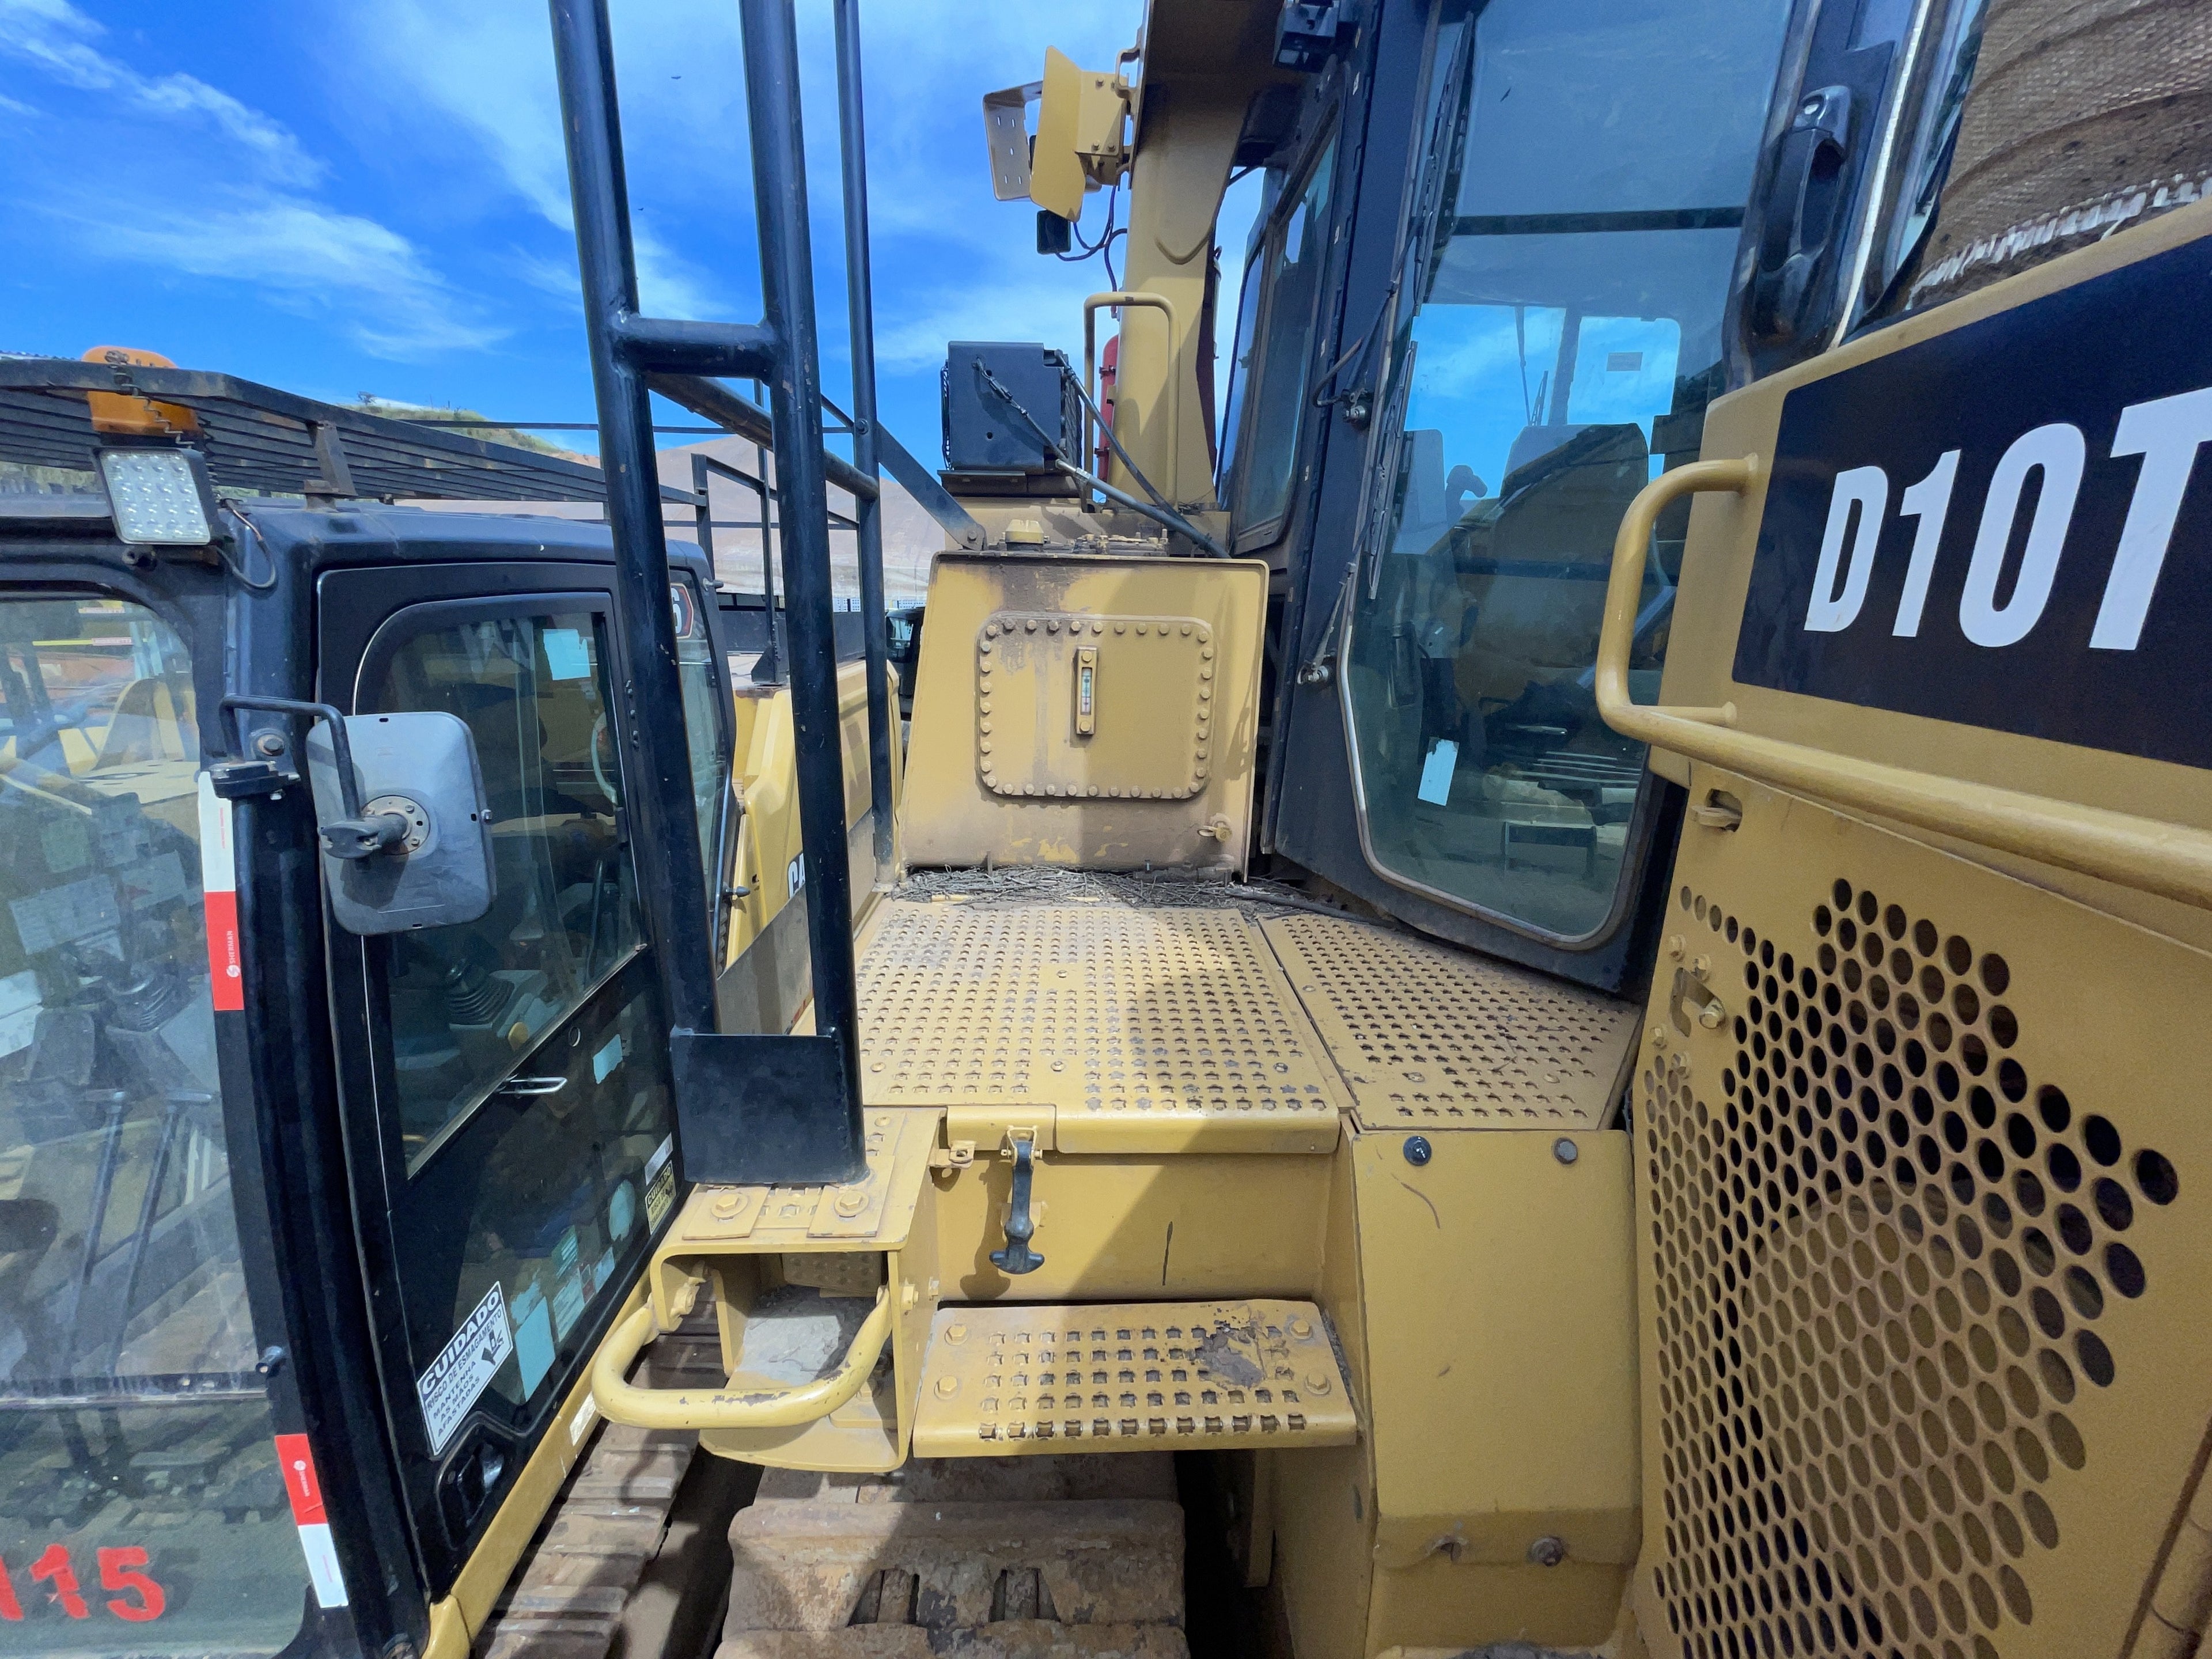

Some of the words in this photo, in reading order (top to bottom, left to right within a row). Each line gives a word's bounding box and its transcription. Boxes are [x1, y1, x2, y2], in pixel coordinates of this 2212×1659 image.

[1804, 387, 2212, 650] D10T
[226, 930, 236, 964] SHERMAN
[647, 1166, 672, 1205] CUIDADO
[422, 1291, 499, 1395] CUIDADO
[427, 1380, 448, 1411] RISCO
[448, 1366, 457, 1384] DE
[458, 1309, 502, 1369] ESMAGAMENTO
[433, 1361, 476, 1419] MANTENHA
[438, 1376, 480, 1437] AFASTADAS
[441, 1406, 450, 1422] AS
